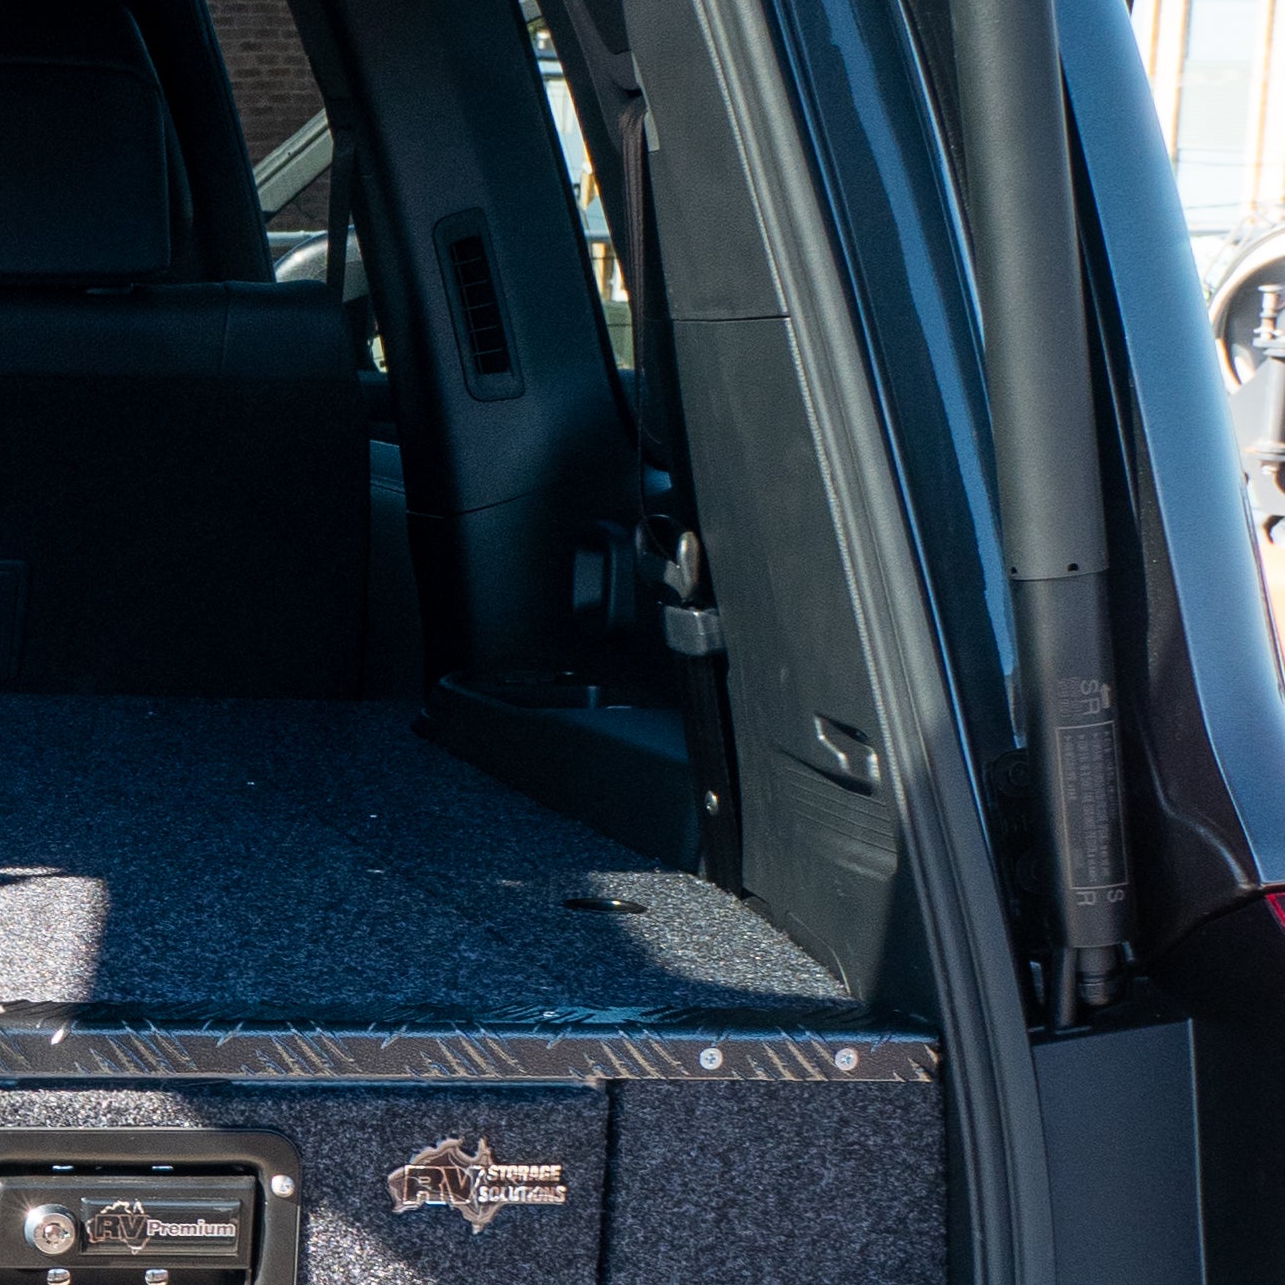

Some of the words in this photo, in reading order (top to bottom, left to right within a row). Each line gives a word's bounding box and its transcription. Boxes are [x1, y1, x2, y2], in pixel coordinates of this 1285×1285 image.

[486, 1164, 562, 1182] STORAGE
[478, 1185, 568, 1203] SOLUTIONS
[95, 1213, 150, 1240] RV
[146, 1218, 236, 1237] Premium
